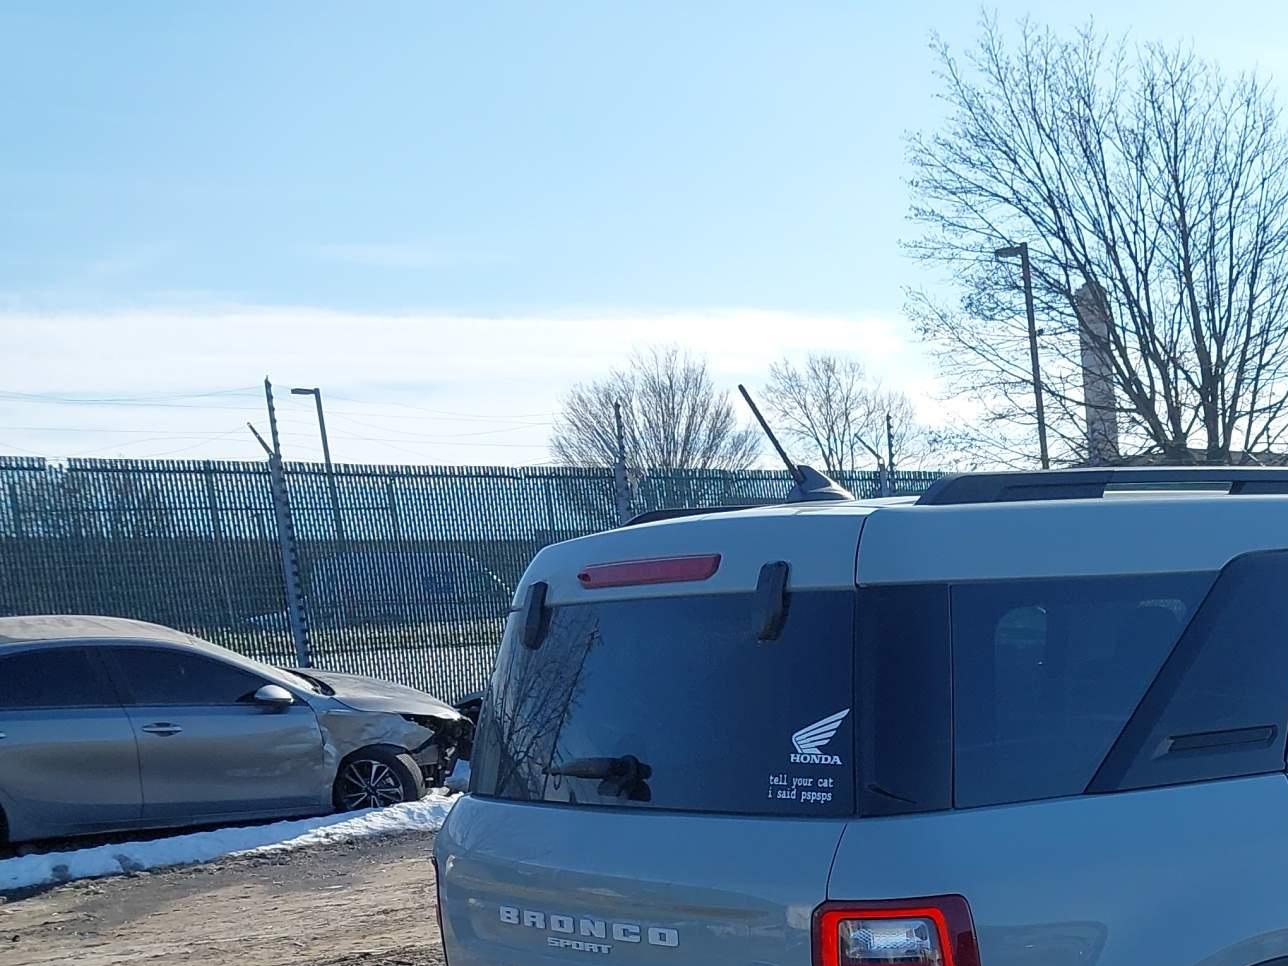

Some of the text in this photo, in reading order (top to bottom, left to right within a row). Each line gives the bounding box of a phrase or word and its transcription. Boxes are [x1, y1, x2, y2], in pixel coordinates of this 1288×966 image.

[790, 753, 843, 765] HONDA
[769, 774, 834, 789] tell your cat
[768, 786, 833, 804] i said pspsps
[499, 905, 680, 947] BRONCO
[547, 937, 612, 954] SPORT
